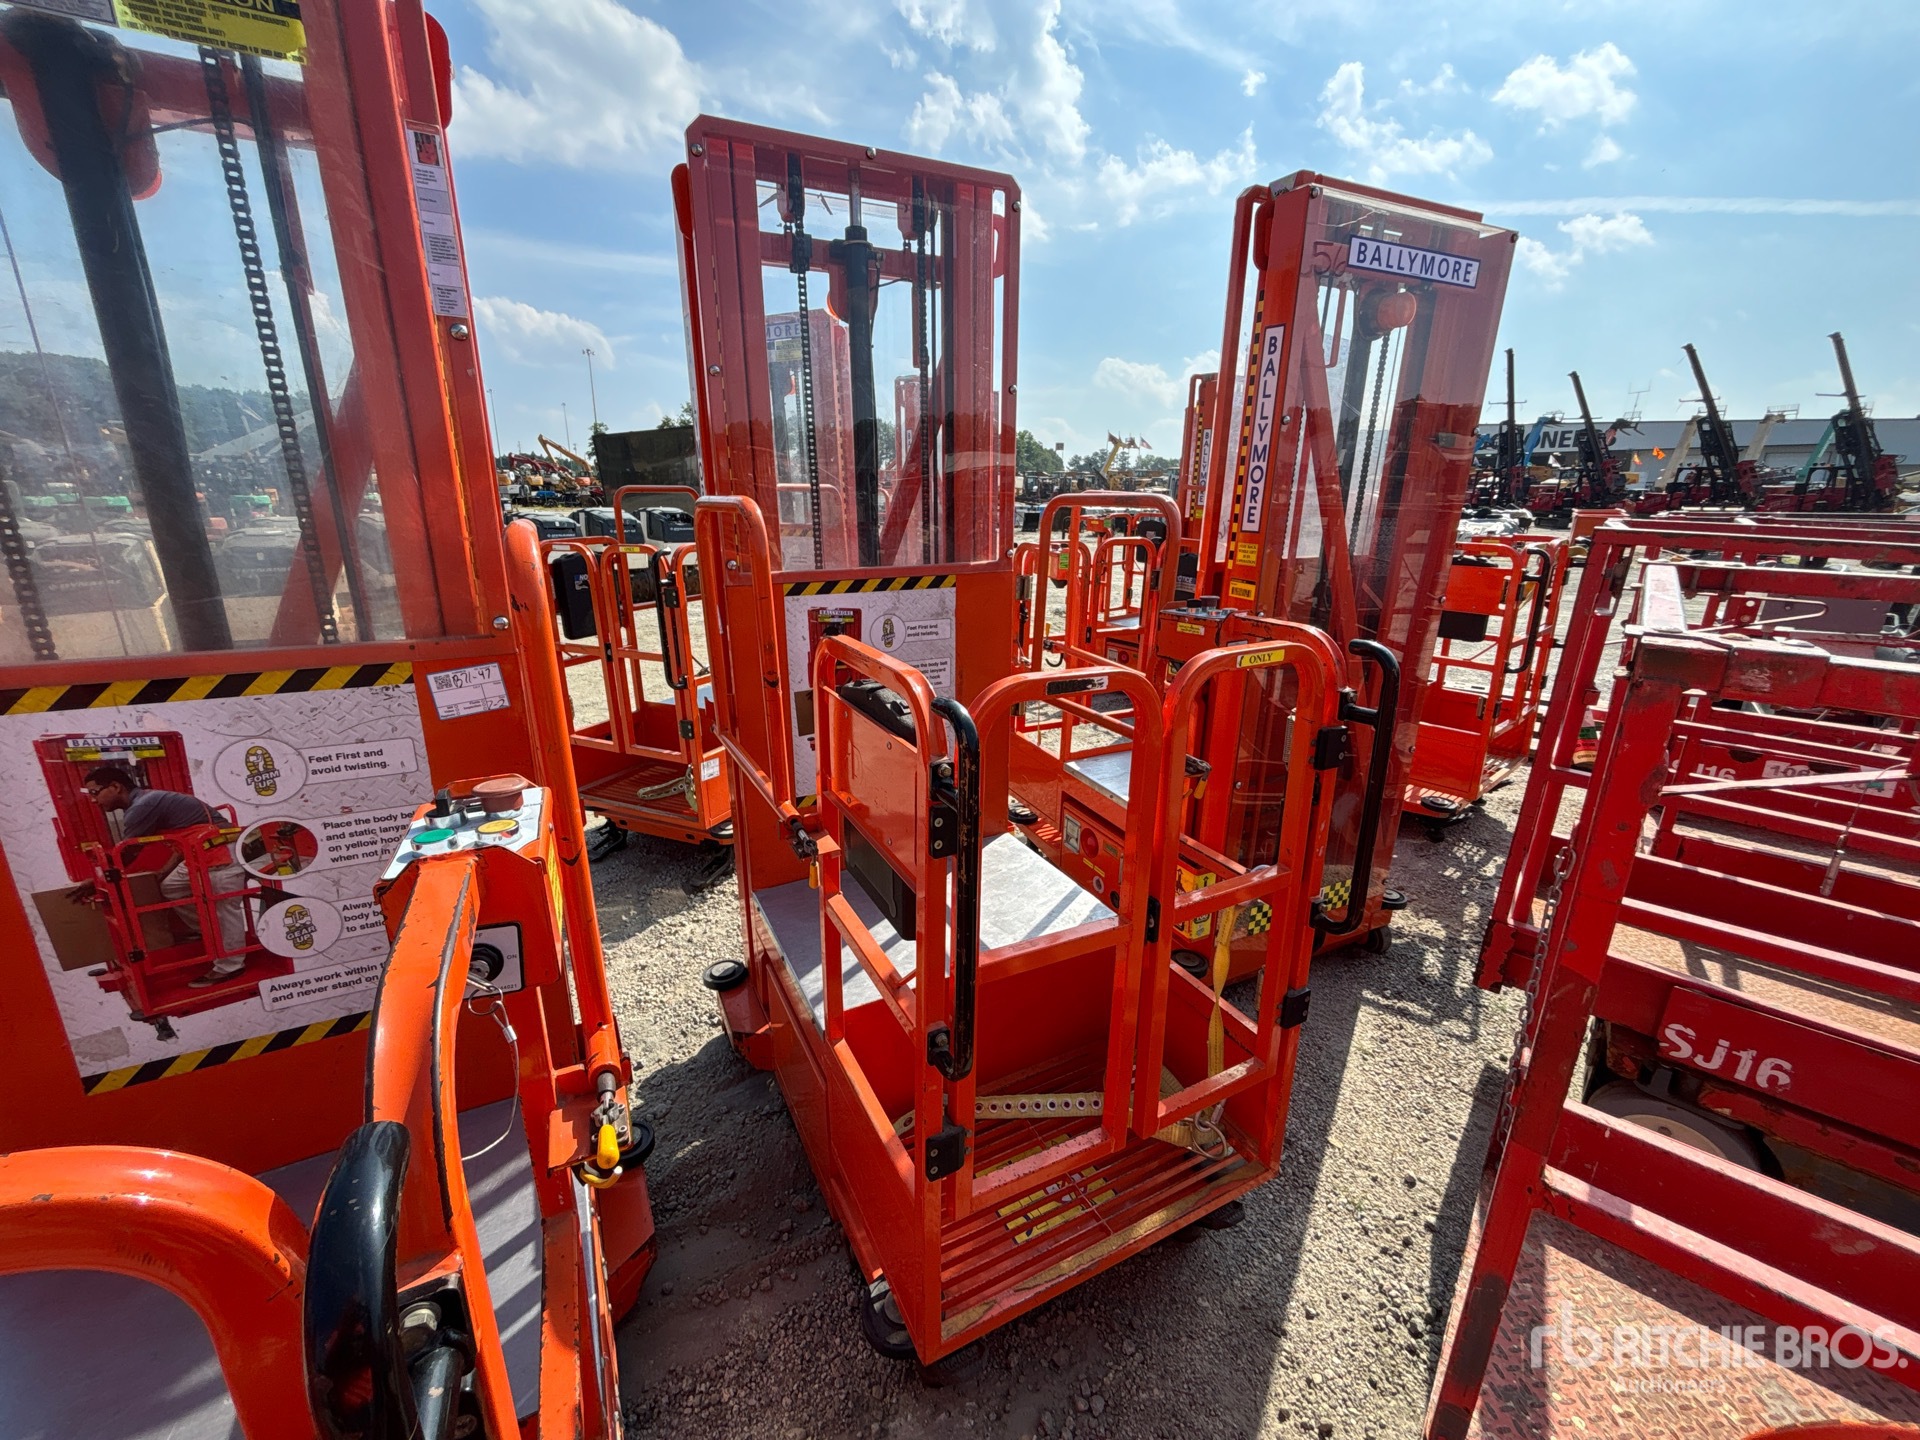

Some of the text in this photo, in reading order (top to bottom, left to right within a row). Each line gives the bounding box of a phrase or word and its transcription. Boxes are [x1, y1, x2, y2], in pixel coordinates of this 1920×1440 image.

[1356, 241, 1473, 283] BALLYMORE
[1247, 336, 1278, 524] BALLYMORE
[1177, 575, 1193, 584] OTICE
[1249, 653, 1273, 665] ONLY
[72, 737, 156, 747] BALLYMORE
[308, 748, 384, 764] Feet First and
[310, 760, 390, 776] avoid twisting.
[247, 769, 280, 785] FORM
[258, 779, 274, 788] UP
[323, 811, 415, 831] Place the body bel
[326, 823, 409, 842] and static lanya
[328, 844, 342, 853] on
[344, 838, 378, 850] yellow
[330, 853, 360, 863] when
[361, 850, 379, 859] not
[344, 911, 370, 922] body
[286, 925, 317, 941] GEAR
[296, 934, 311, 943] UP
[269, 978, 312, 993] Always
[313, 972, 342, 983] work
[344, 965, 377, 977] within
[271, 975, 379, 1004] and never stand on
[1659, 1023, 1794, 1092] SJ16
